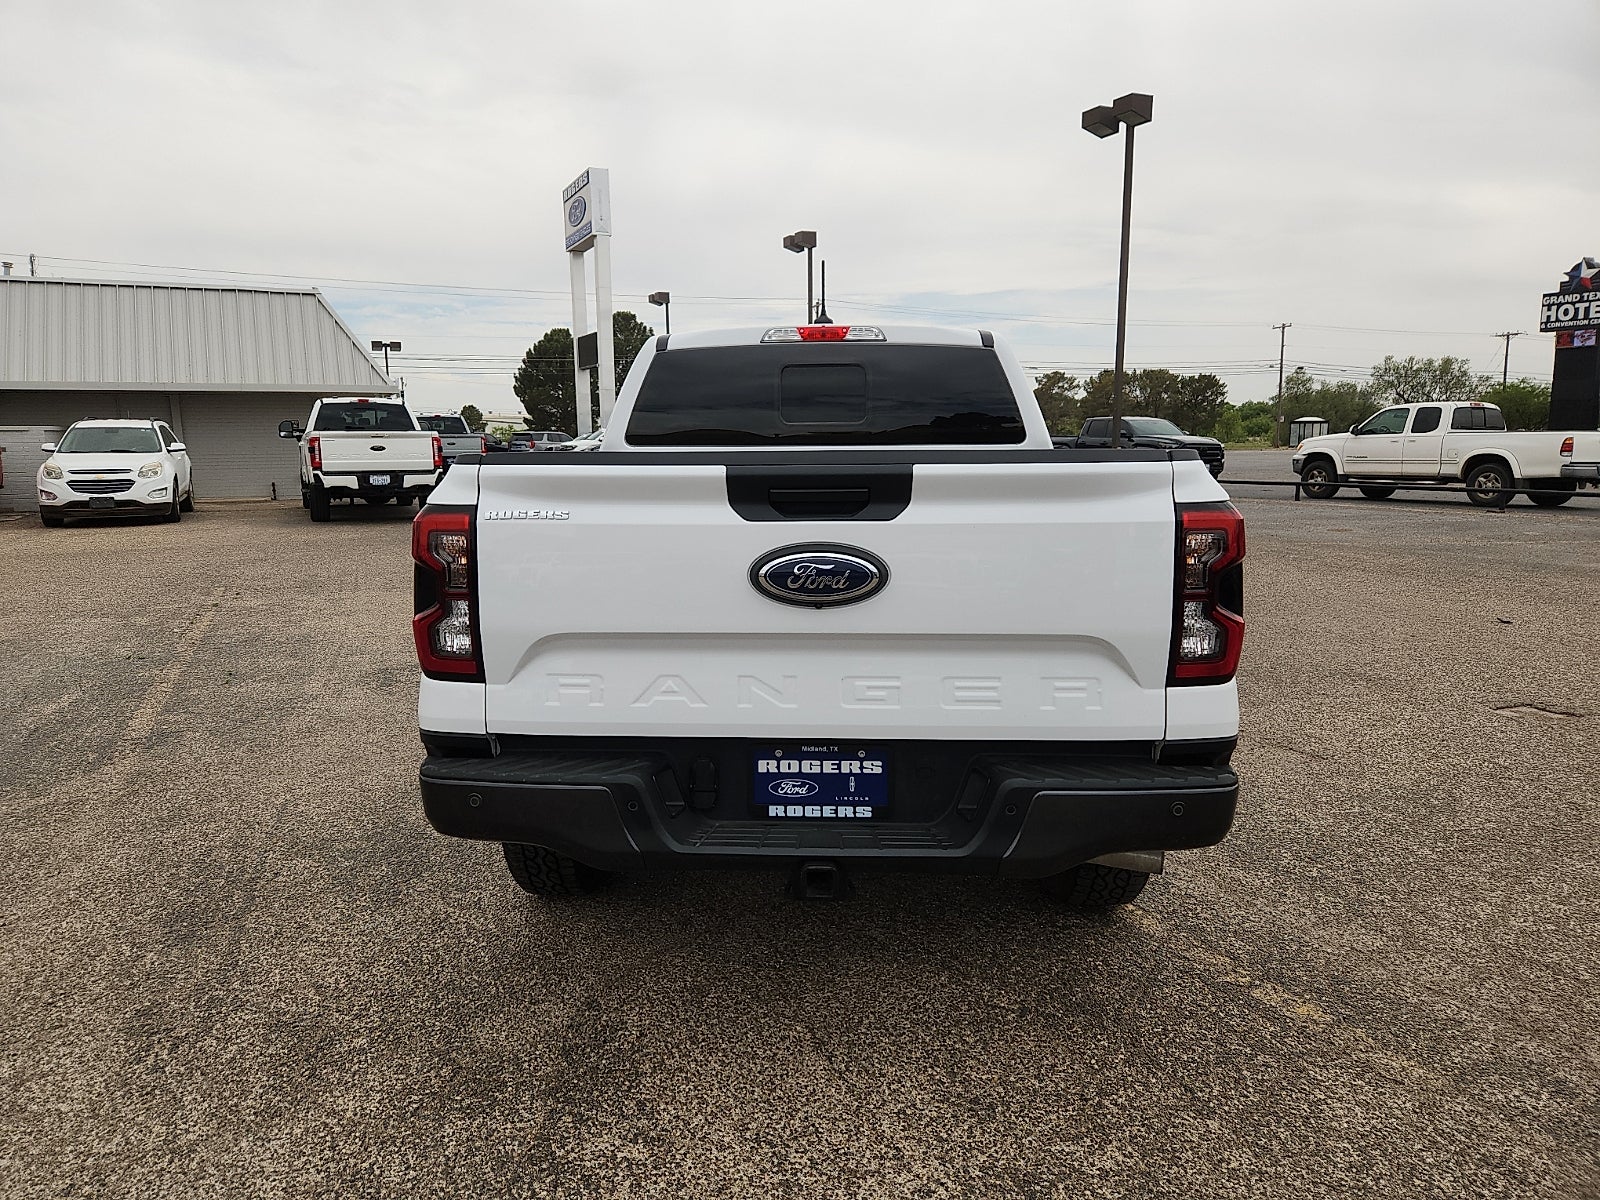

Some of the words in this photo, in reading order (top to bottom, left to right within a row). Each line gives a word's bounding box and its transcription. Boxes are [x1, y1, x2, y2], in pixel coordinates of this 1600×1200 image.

[1543, 294, 1580, 305] GRAND
[1541, 302, 1600, 322] HOTE
[1547, 319, 1589, 328] CONVENTION
[485, 510, 569, 520] ROGERS
[787, 563, 851, 589] Ford
[544, 674, 1103, 710] RANGER
[757, 760, 883, 773] ROGERS
[777, 781, 809, 794] Ford
[768, 805, 873, 818] ROGERS
